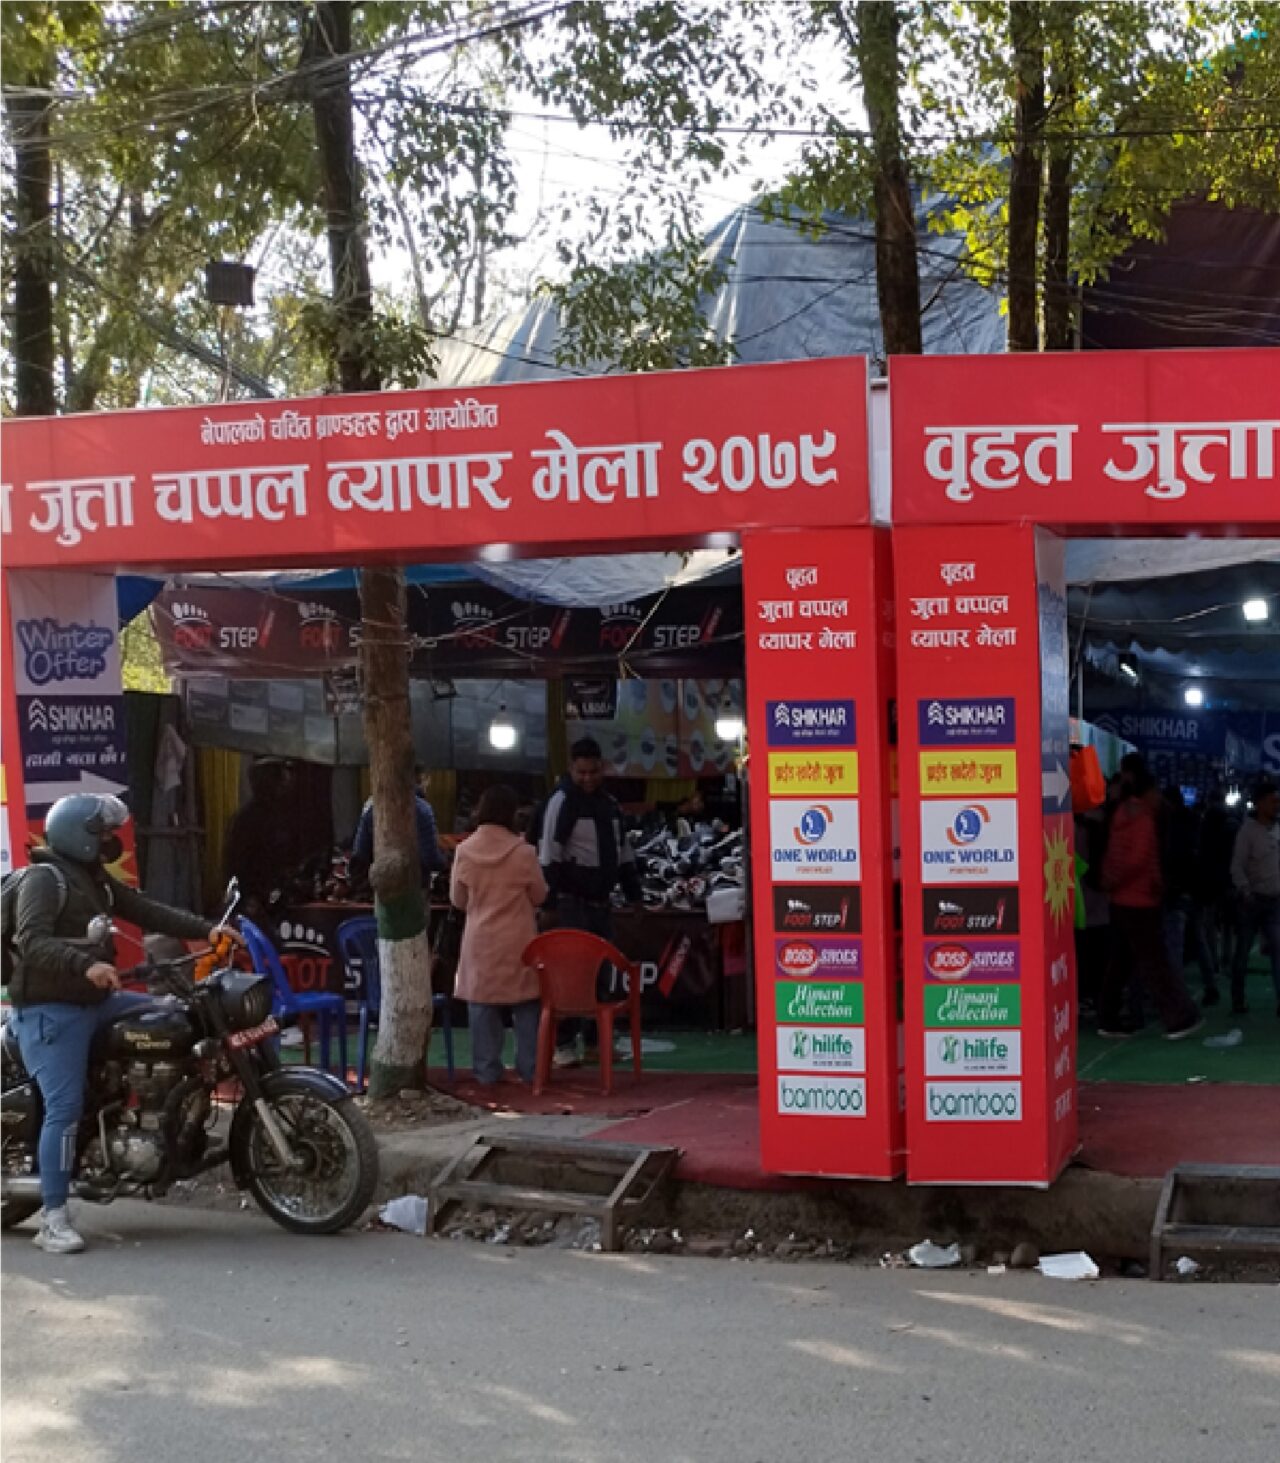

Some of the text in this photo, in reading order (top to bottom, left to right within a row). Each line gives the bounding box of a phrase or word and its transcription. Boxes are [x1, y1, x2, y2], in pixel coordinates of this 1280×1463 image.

[201, 413, 265, 445] नेपालको
[270, 410, 312, 441] चर्चित
[385, 409, 420, 441] द्वारा
[425, 398, 498, 435] आयोजित
[924, 424, 1079, 501] वृहत
[26, 474, 136, 547] जुत्ता
[152, 464, 310, 523] चप्पल
[326, 452, 513, 512] व्यापार
[531, 429, 663, 503] मेला
[682, 429, 837, 494] २०७९
[20, 620, 111, 651] Winter
[173, 625, 258, 648] FOOT STEP
[506, 626, 550, 648] STEP
[654, 625, 700, 648] STEP
[29, 648, 104, 681] Offer
[49, 704, 114, 730] SHIKHAR
[791, 707, 847, 728] SHIKHAR
[944, 705, 1005, 726] SHIKHAR
[1120, 714, 1199, 740] SHIKHAR
[774, 849, 857, 862] ONE WORLD
[923, 848, 1015, 864] ONE WORLD
[784, 913, 841, 928] FOOT STEP
[934, 915, 996, 929] FOOT STEP
[784, 948, 859, 965] BOSS SHOES
[934, 951, 1014, 967] BOSS SHOES
[793, 984, 845, 1003] Himani
[947, 987, 999, 1004] Himani
[788, 1000, 852, 1018] Collection
[937, 1003, 1008, 1021] Collection
[812, 1034, 853, 1055] hilife
[964, 1037, 1008, 1058] hilife
[781, 1084, 863, 1111] bamboo
[930, 1088, 1015, 1116] bamboo
